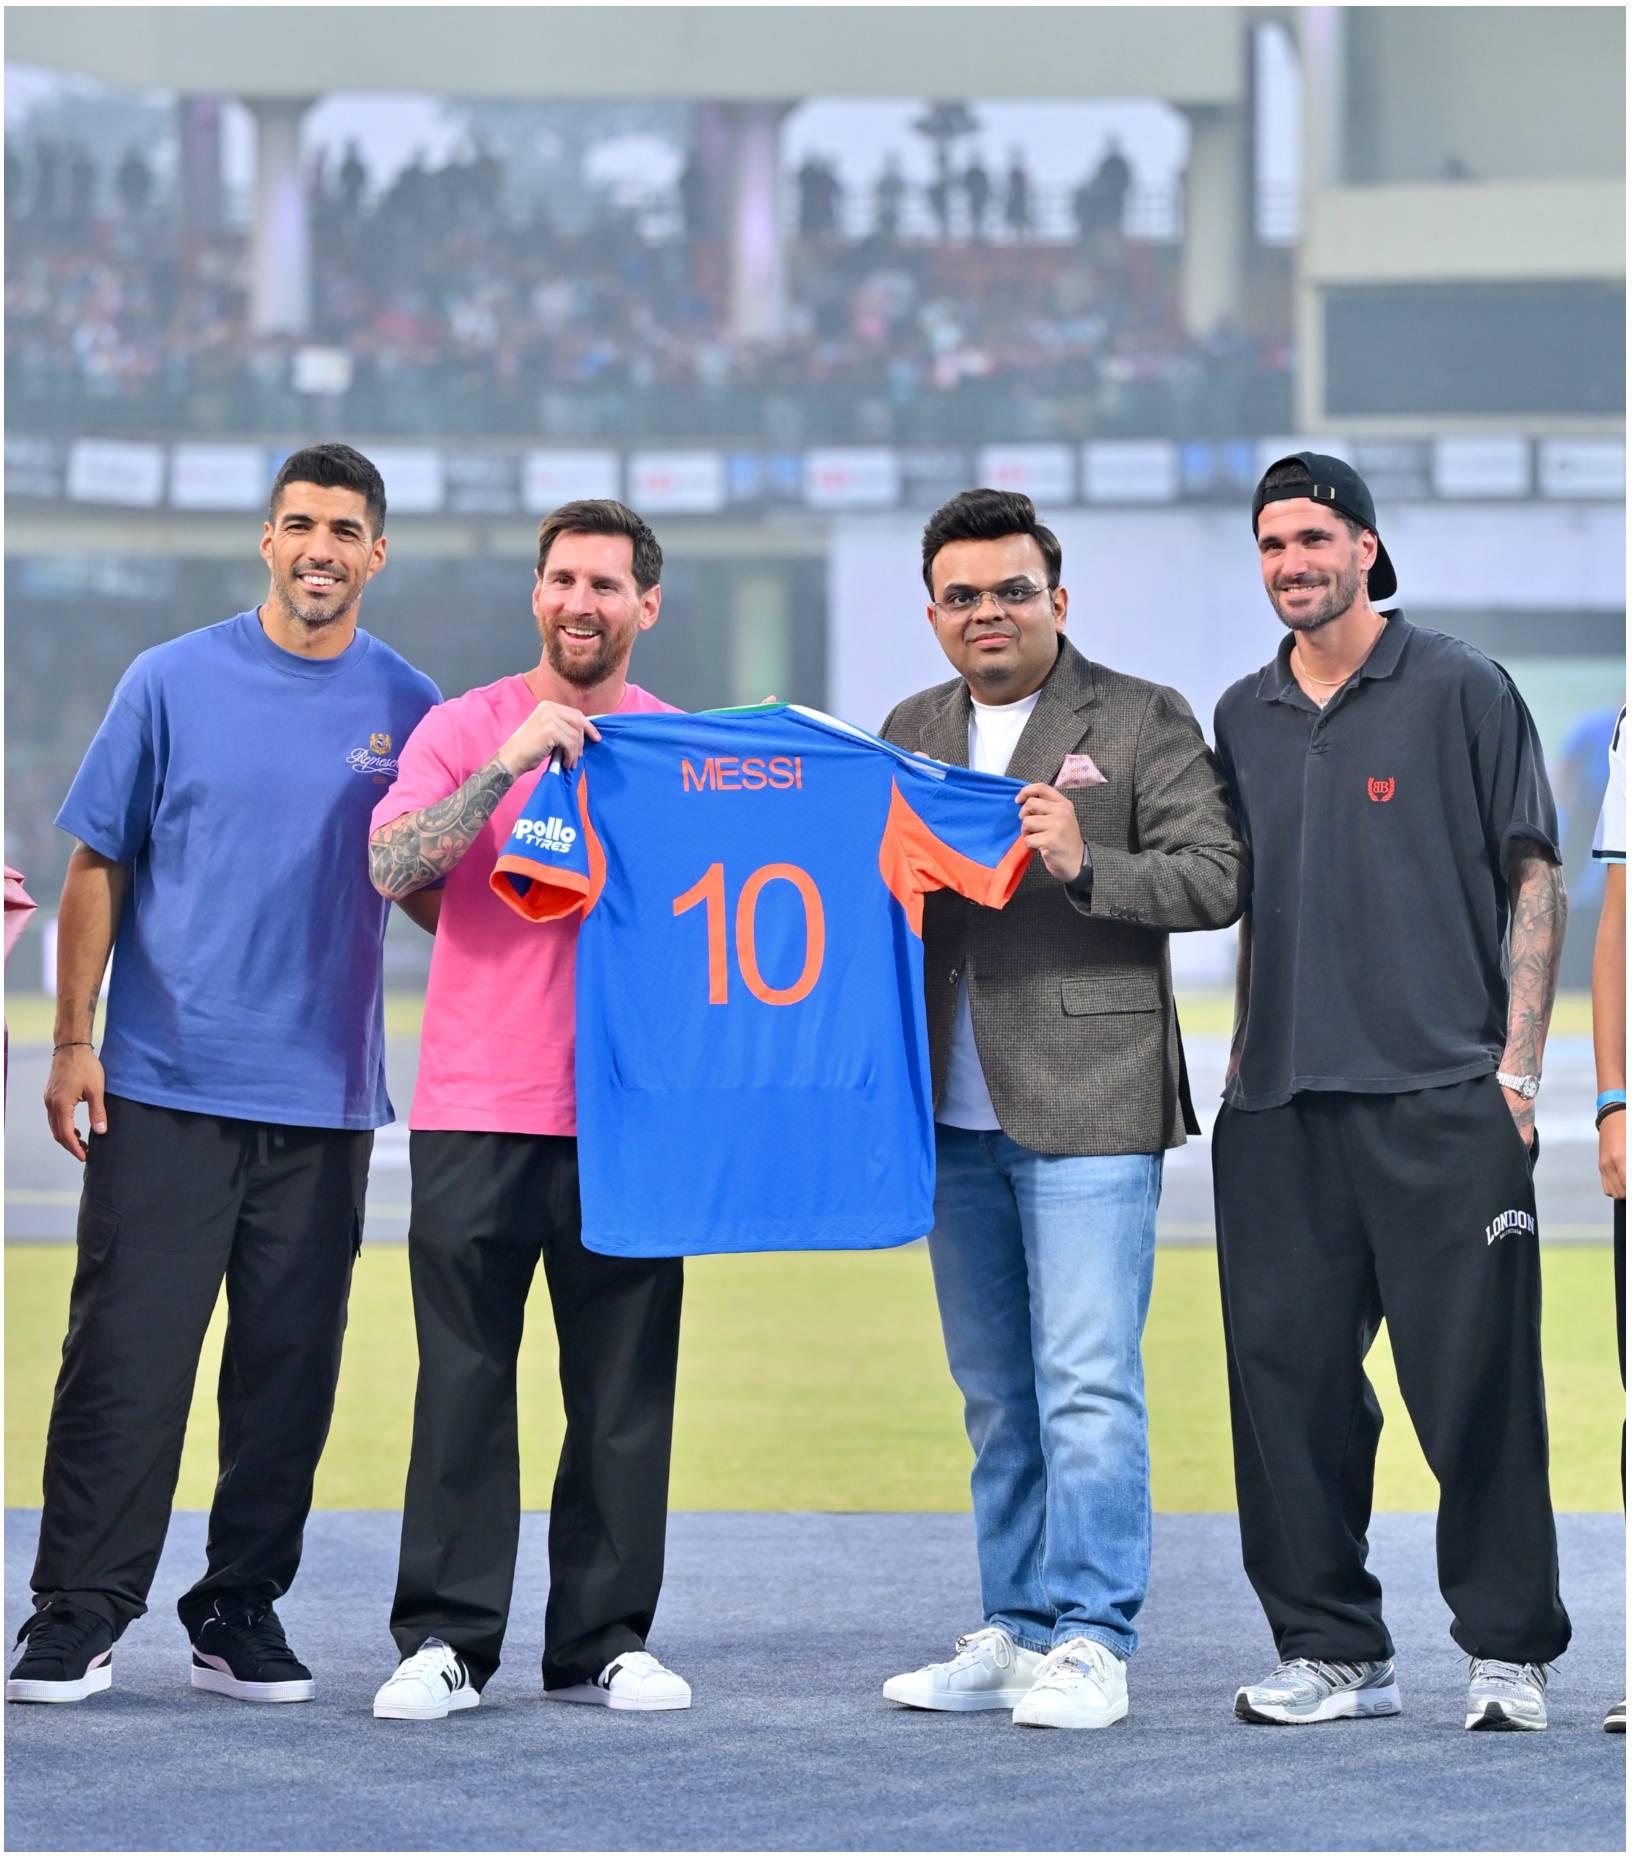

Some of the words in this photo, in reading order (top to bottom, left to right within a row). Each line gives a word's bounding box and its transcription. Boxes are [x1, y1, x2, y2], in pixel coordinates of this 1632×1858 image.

[681, 755, 804, 793] MESSI
[512, 816, 577, 844] pollo
[525, 834, 573, 854] TYRES
[672, 862, 826, 1006] 10
[1485, 1209, 1535, 1246] LONDON
